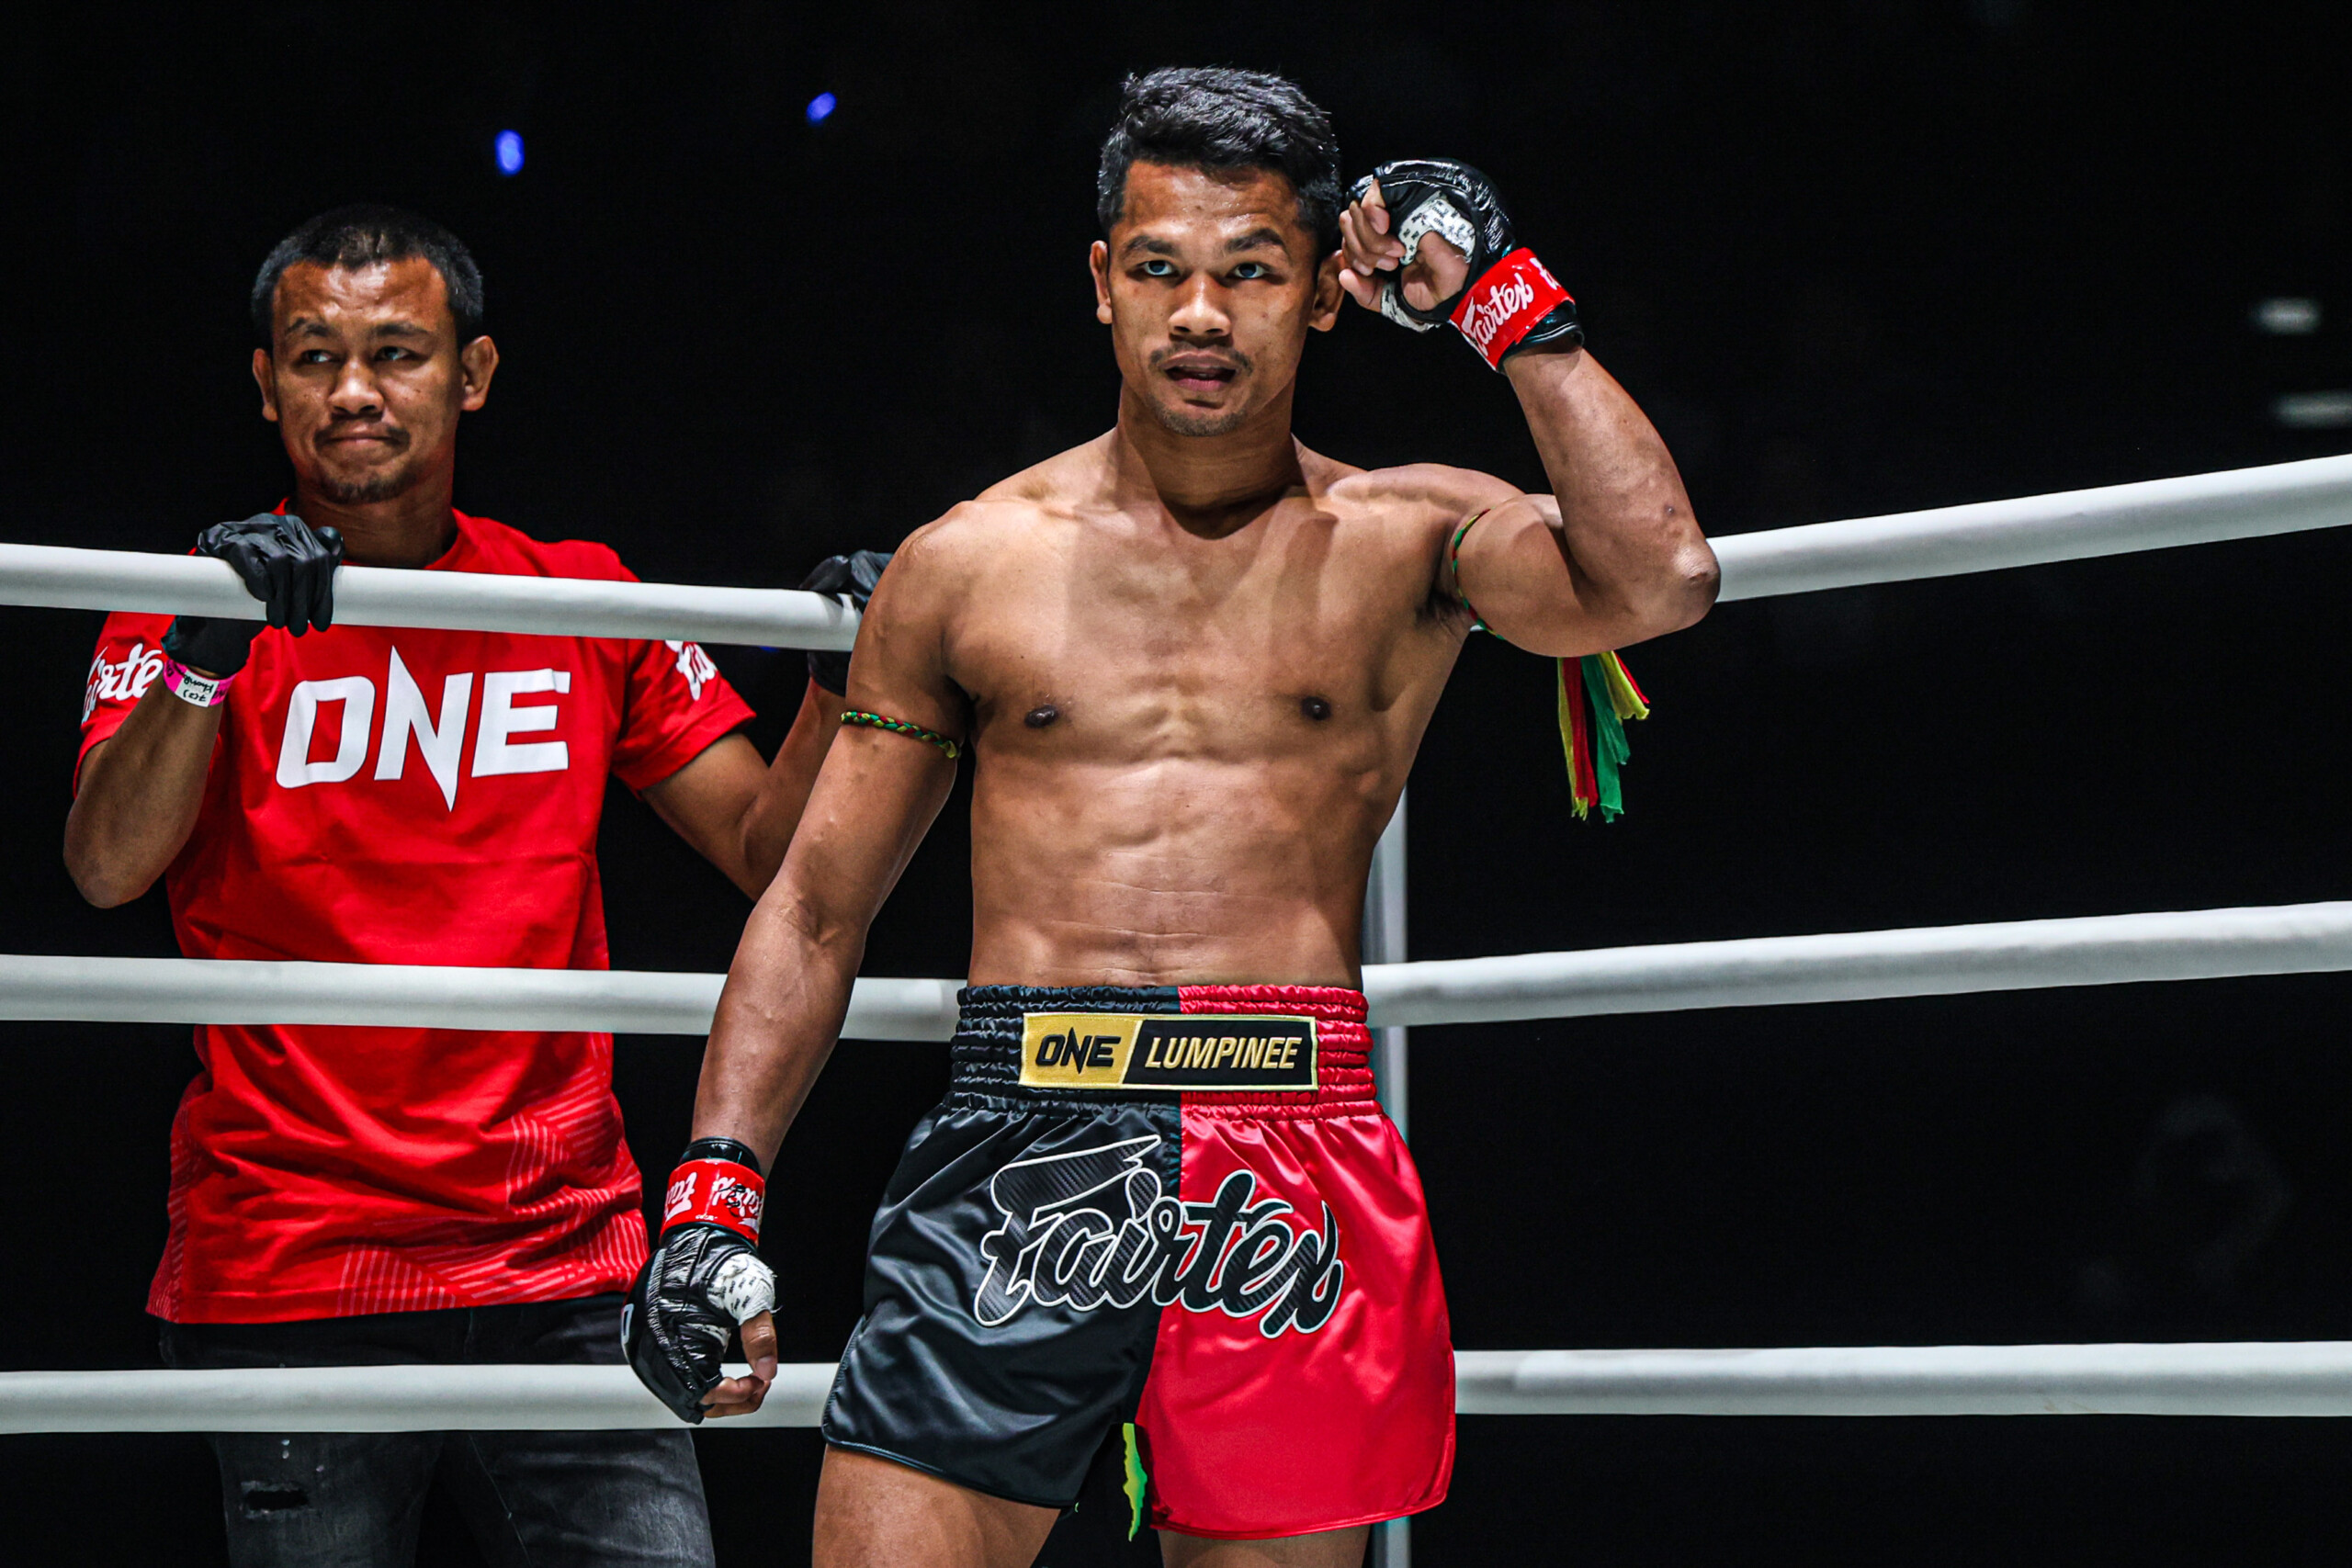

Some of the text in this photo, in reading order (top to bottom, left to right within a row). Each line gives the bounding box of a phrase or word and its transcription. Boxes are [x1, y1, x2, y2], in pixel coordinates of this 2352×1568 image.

[1460, 272, 1534, 357] Fairtex
[276, 645, 571, 812] ONE
[1035, 1026, 1303, 1075] ONE LUMPINEE
[974, 1134, 1344, 1339] Fairtex
